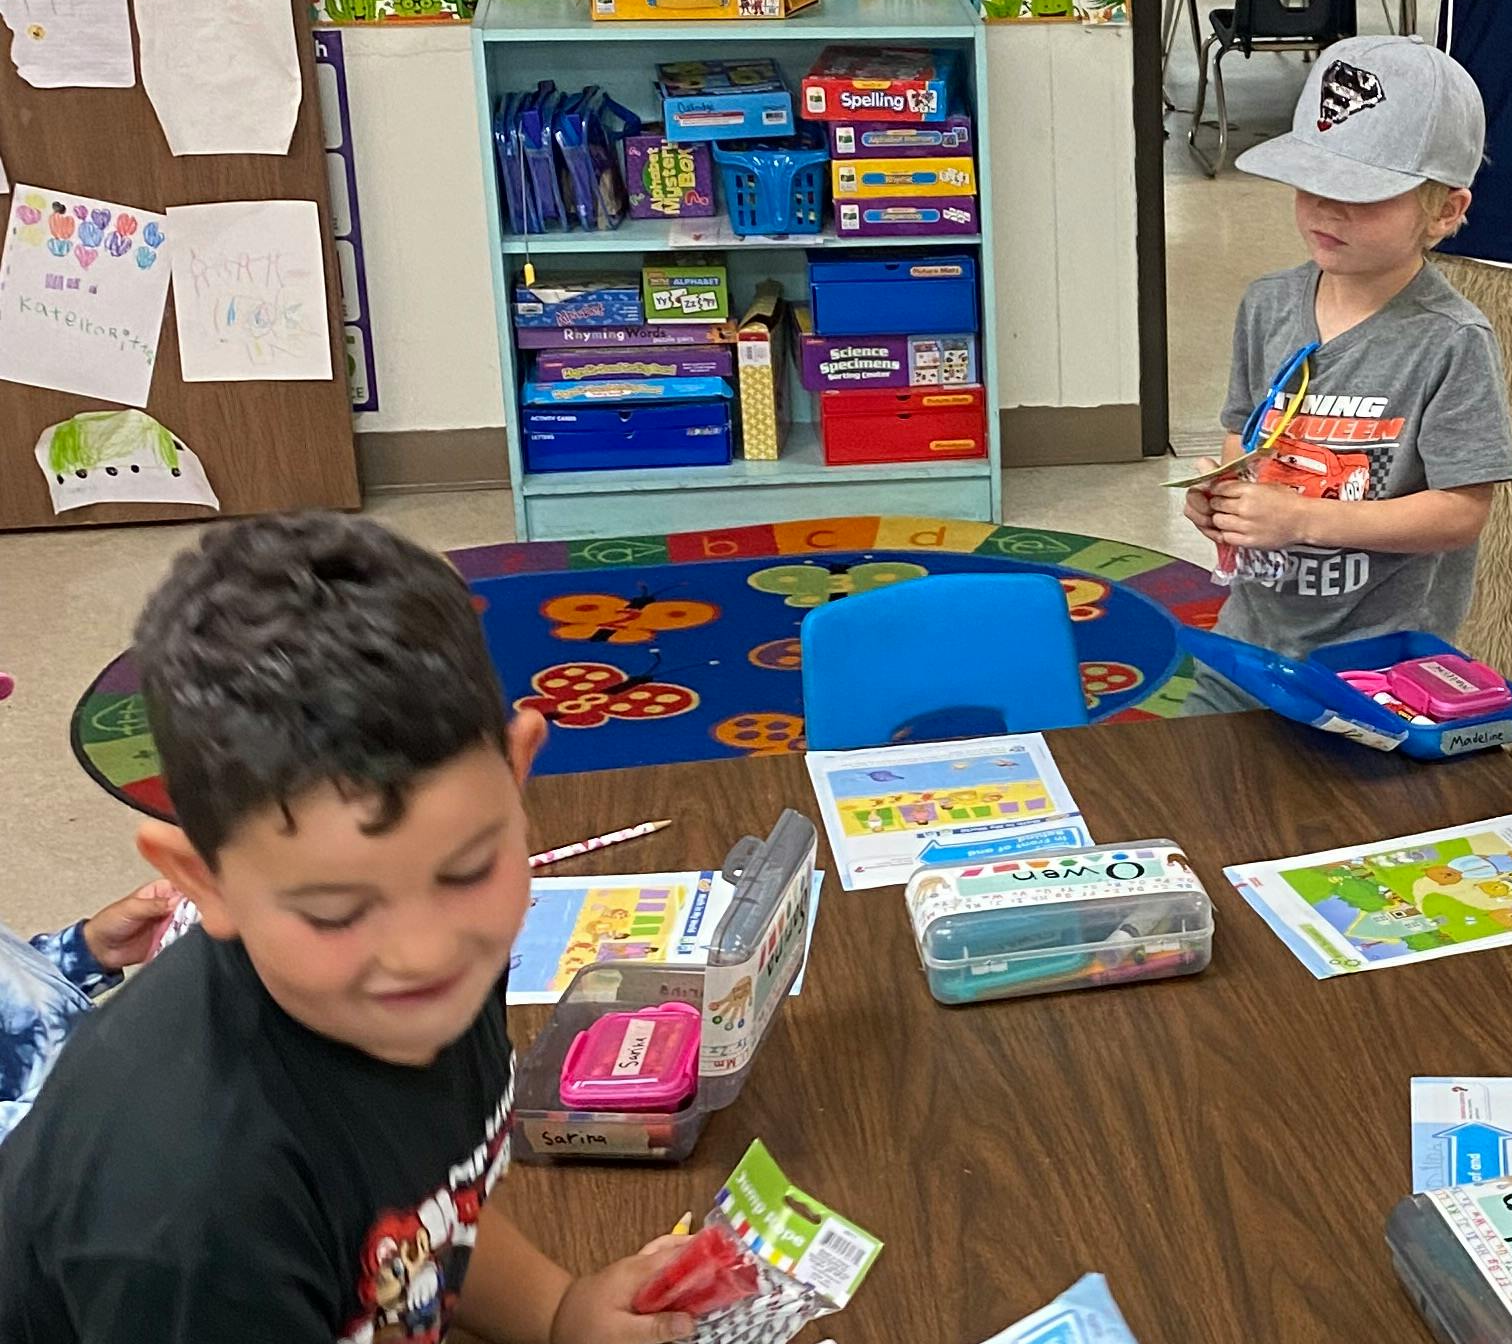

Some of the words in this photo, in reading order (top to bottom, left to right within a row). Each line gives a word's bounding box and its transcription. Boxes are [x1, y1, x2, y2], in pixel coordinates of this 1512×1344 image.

[840, 92, 905, 112] Spelling
[678, 148, 697, 187] Box
[672, 276, 720, 287] ALPHABET
[563, 327, 625, 342] Rhyming
[625, 327, 667, 339] Words
[829, 346, 889, 360] Science
[819, 358, 901, 376] Specimens
[827, 371, 861, 381] Sorting
[703, 535, 738, 557] b
[806, 526, 836, 548] c
[910, 525, 946, 548] d
[1450, 730, 1504, 750] Madeline
[1012, 860, 1146, 882] Owen
[541, 1130, 608, 1146] Sarina
